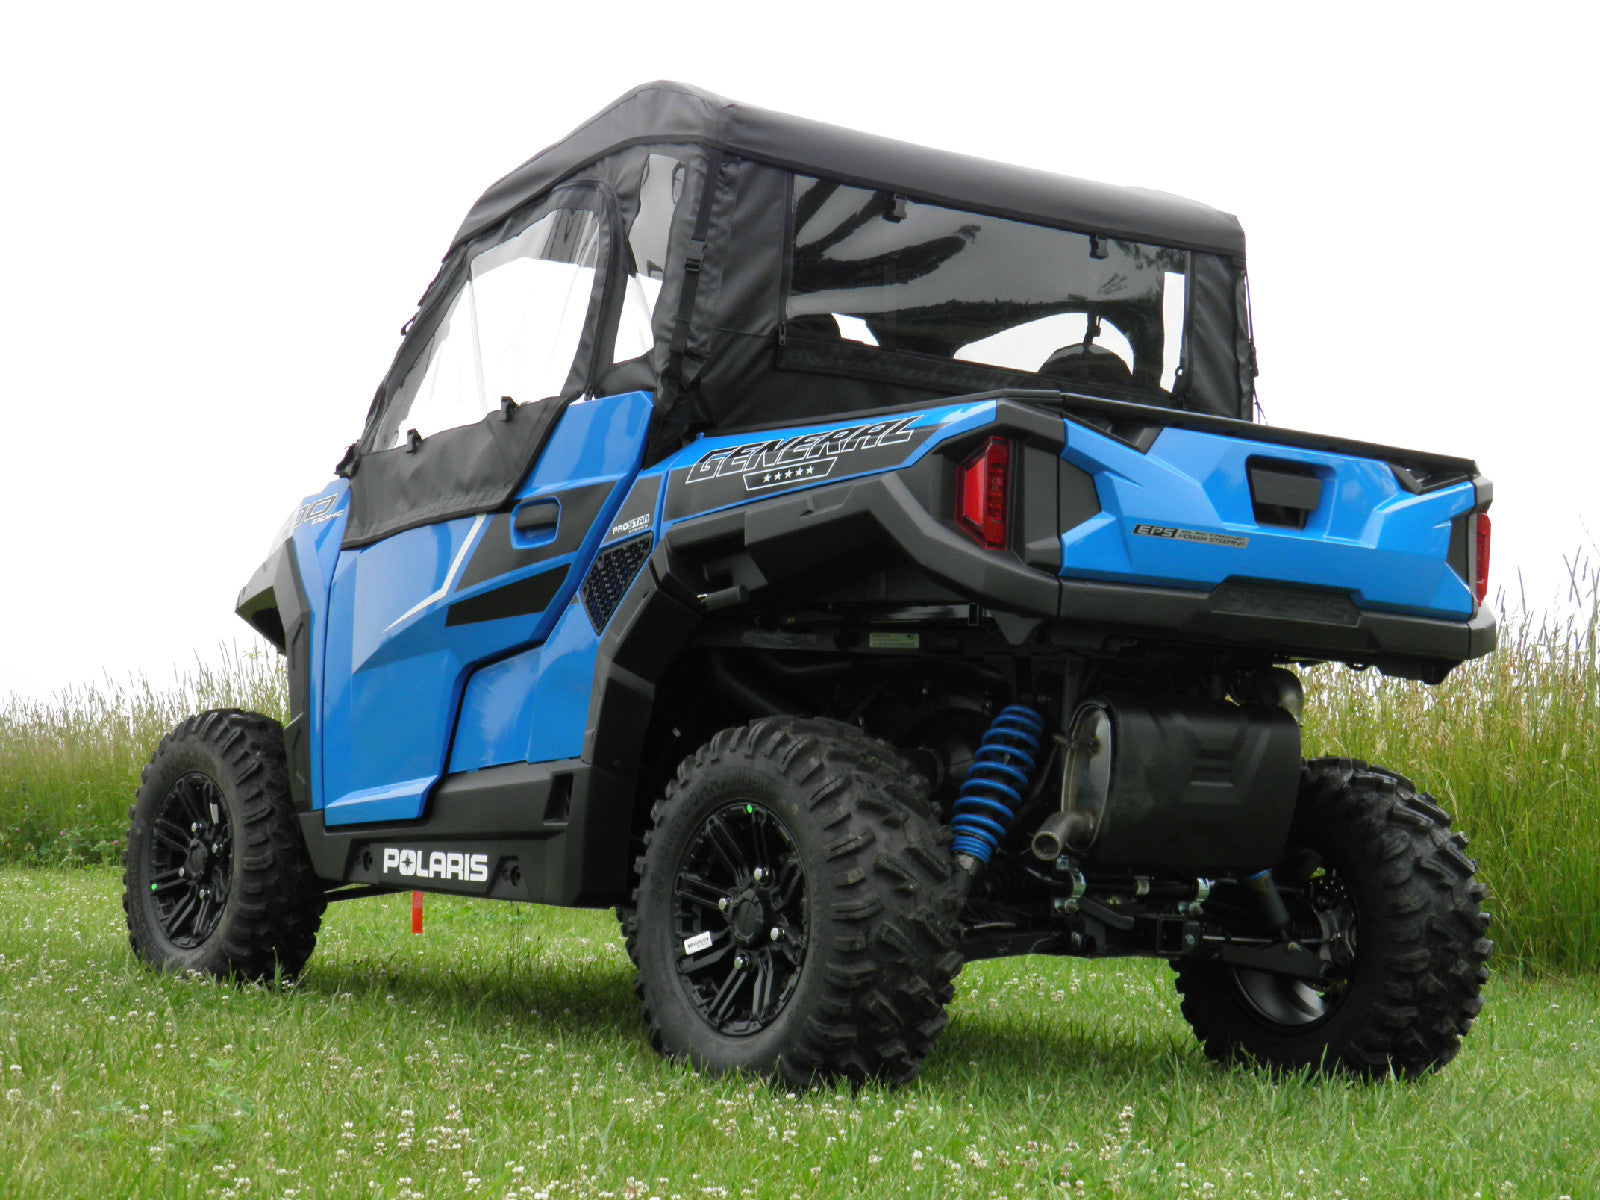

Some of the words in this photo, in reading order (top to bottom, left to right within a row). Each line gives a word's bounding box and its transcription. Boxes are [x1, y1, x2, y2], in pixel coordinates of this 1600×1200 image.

[685, 414, 925, 484] GENERAL
[612, 513, 650, 535] PROSTAR
[1137, 525, 1177, 538] EPS
[1178, 532, 1208, 542] POWER
[1209, 536, 1247, 547] STEERING
[383, 848, 488, 882] POLARIS
